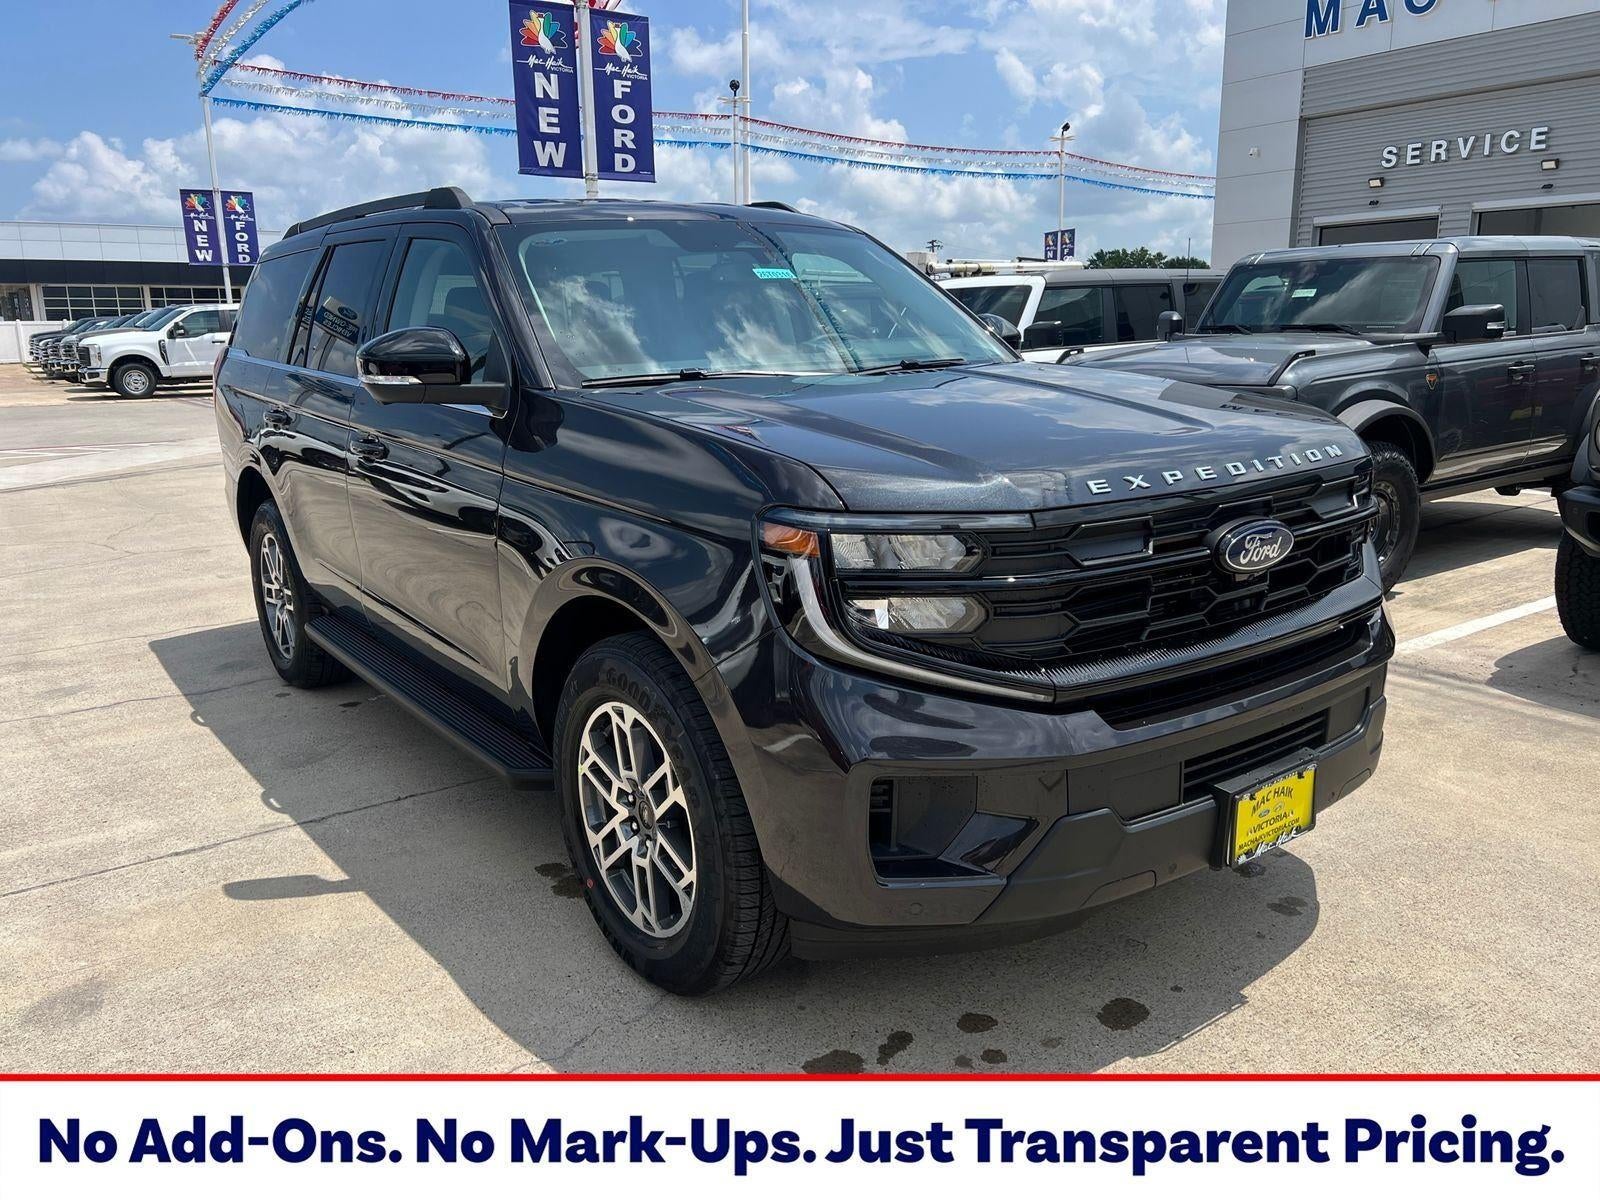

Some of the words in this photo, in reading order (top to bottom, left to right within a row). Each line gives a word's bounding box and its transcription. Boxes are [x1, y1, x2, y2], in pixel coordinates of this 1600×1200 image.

[521, 54, 545, 70] Mac
[545, 55, 569, 70] Haik
[551, 66, 574, 74] VICTORIA
[626, 73, 648, 81] VICTORIA
[533, 72, 567, 168] NEW
[611, 79, 637, 173] FORD
[1380, 126, 1550, 169] SERVICE
[193, 220, 213, 262] NEW
[235, 221, 251, 263] FORD
[1086, 444, 1343, 495] EXPEDITION
[1240, 532, 1284, 564] Ford
[1251, 790, 1272, 816] MAC
[1273, 786, 1294, 799] HAIK
[1252, 811, 1290, 834] VICTORIA
